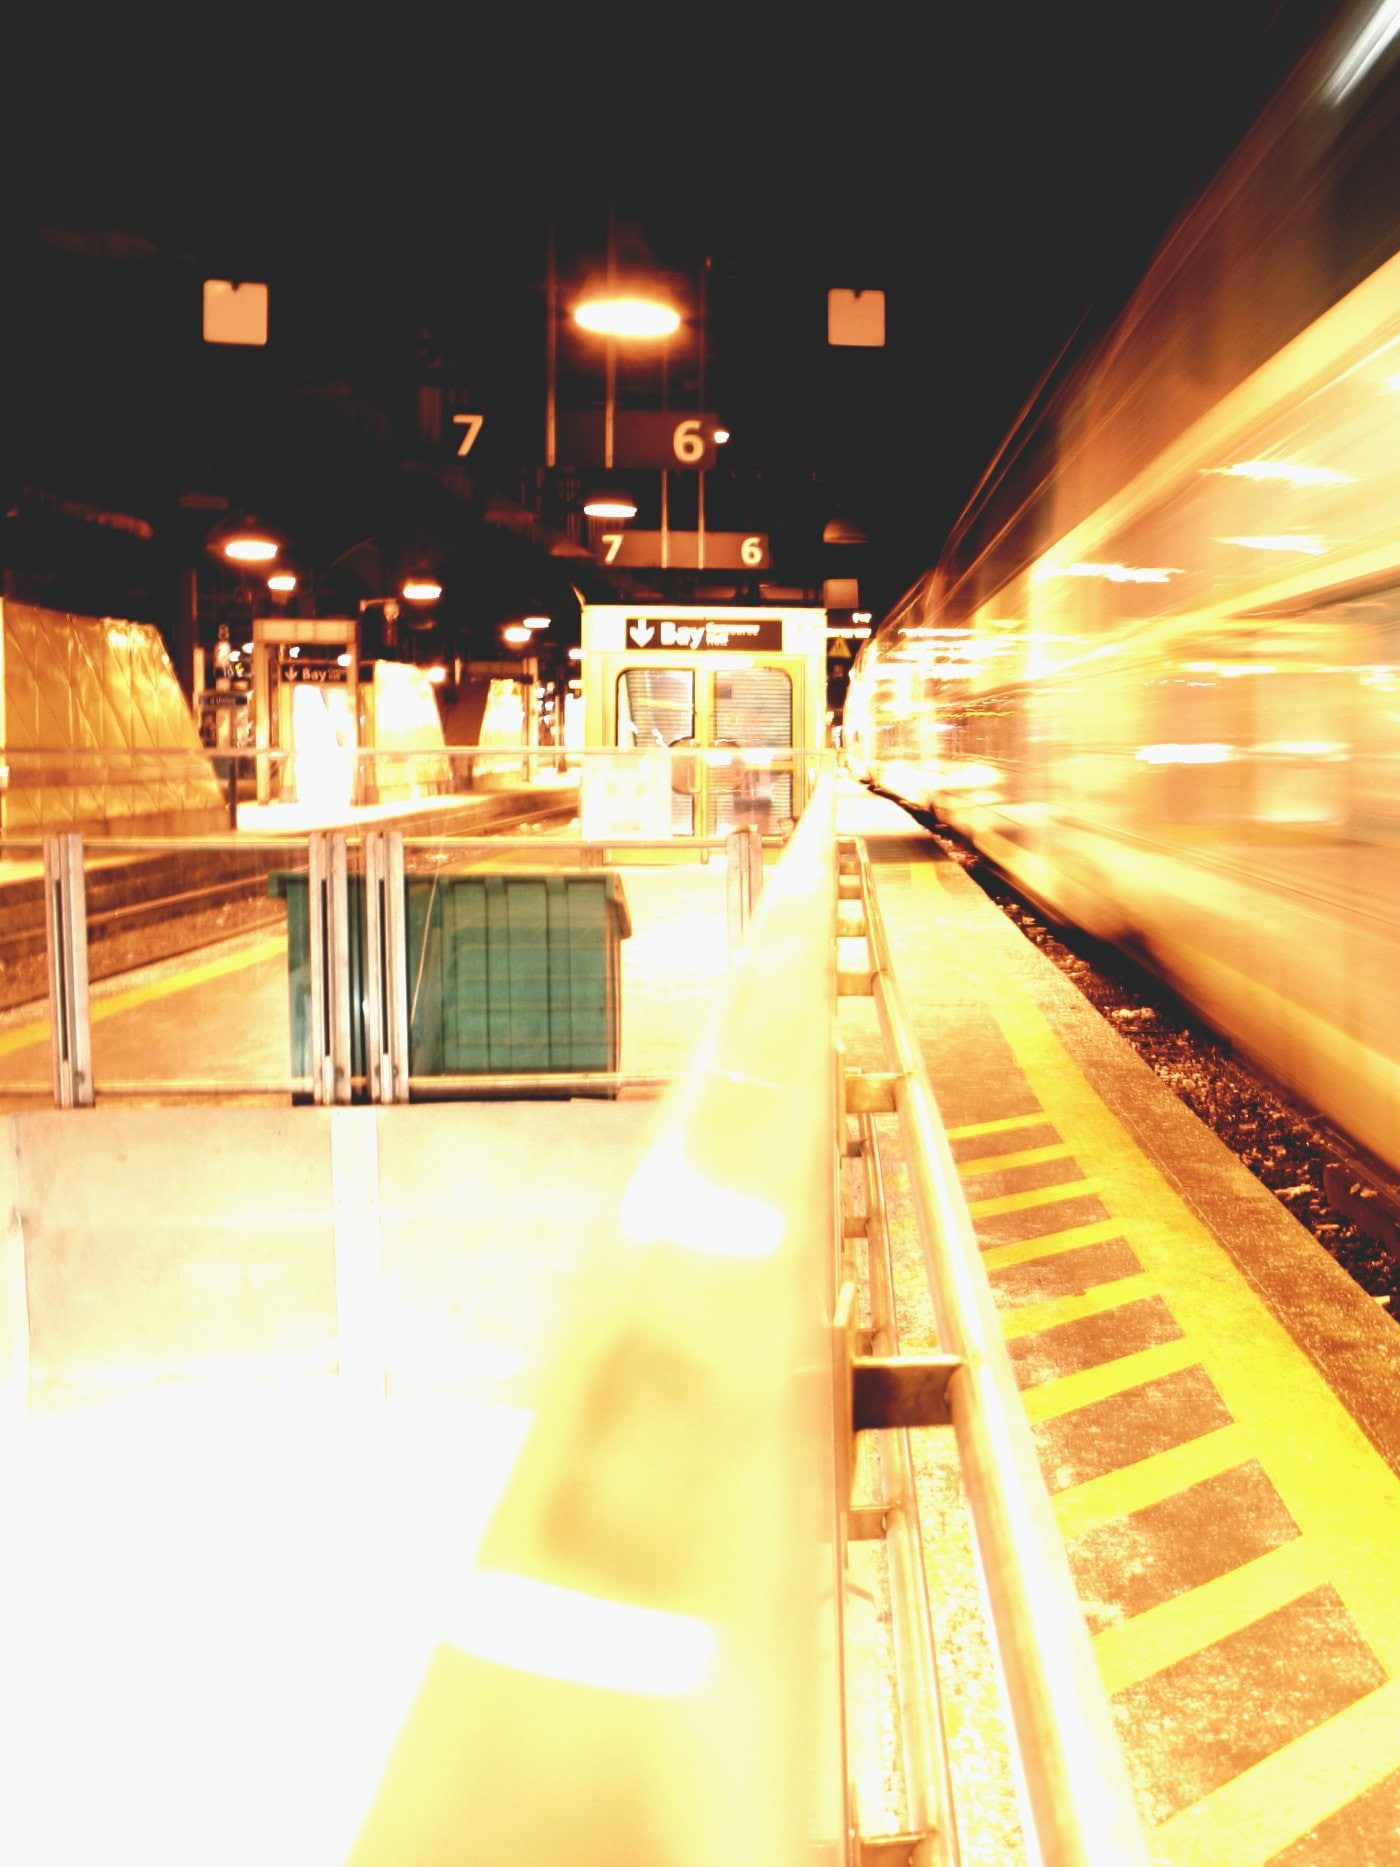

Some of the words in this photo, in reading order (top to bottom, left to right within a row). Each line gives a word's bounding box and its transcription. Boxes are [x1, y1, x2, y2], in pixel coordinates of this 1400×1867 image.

[452, 414, 485, 456] 7
[673, 420, 704, 463] 6
[601, 534, 624, 564] 7
[740, 537, 763, 565] 6
[660, 622, 706, 650] Bay
[302, 667, 327, 682] Bay
